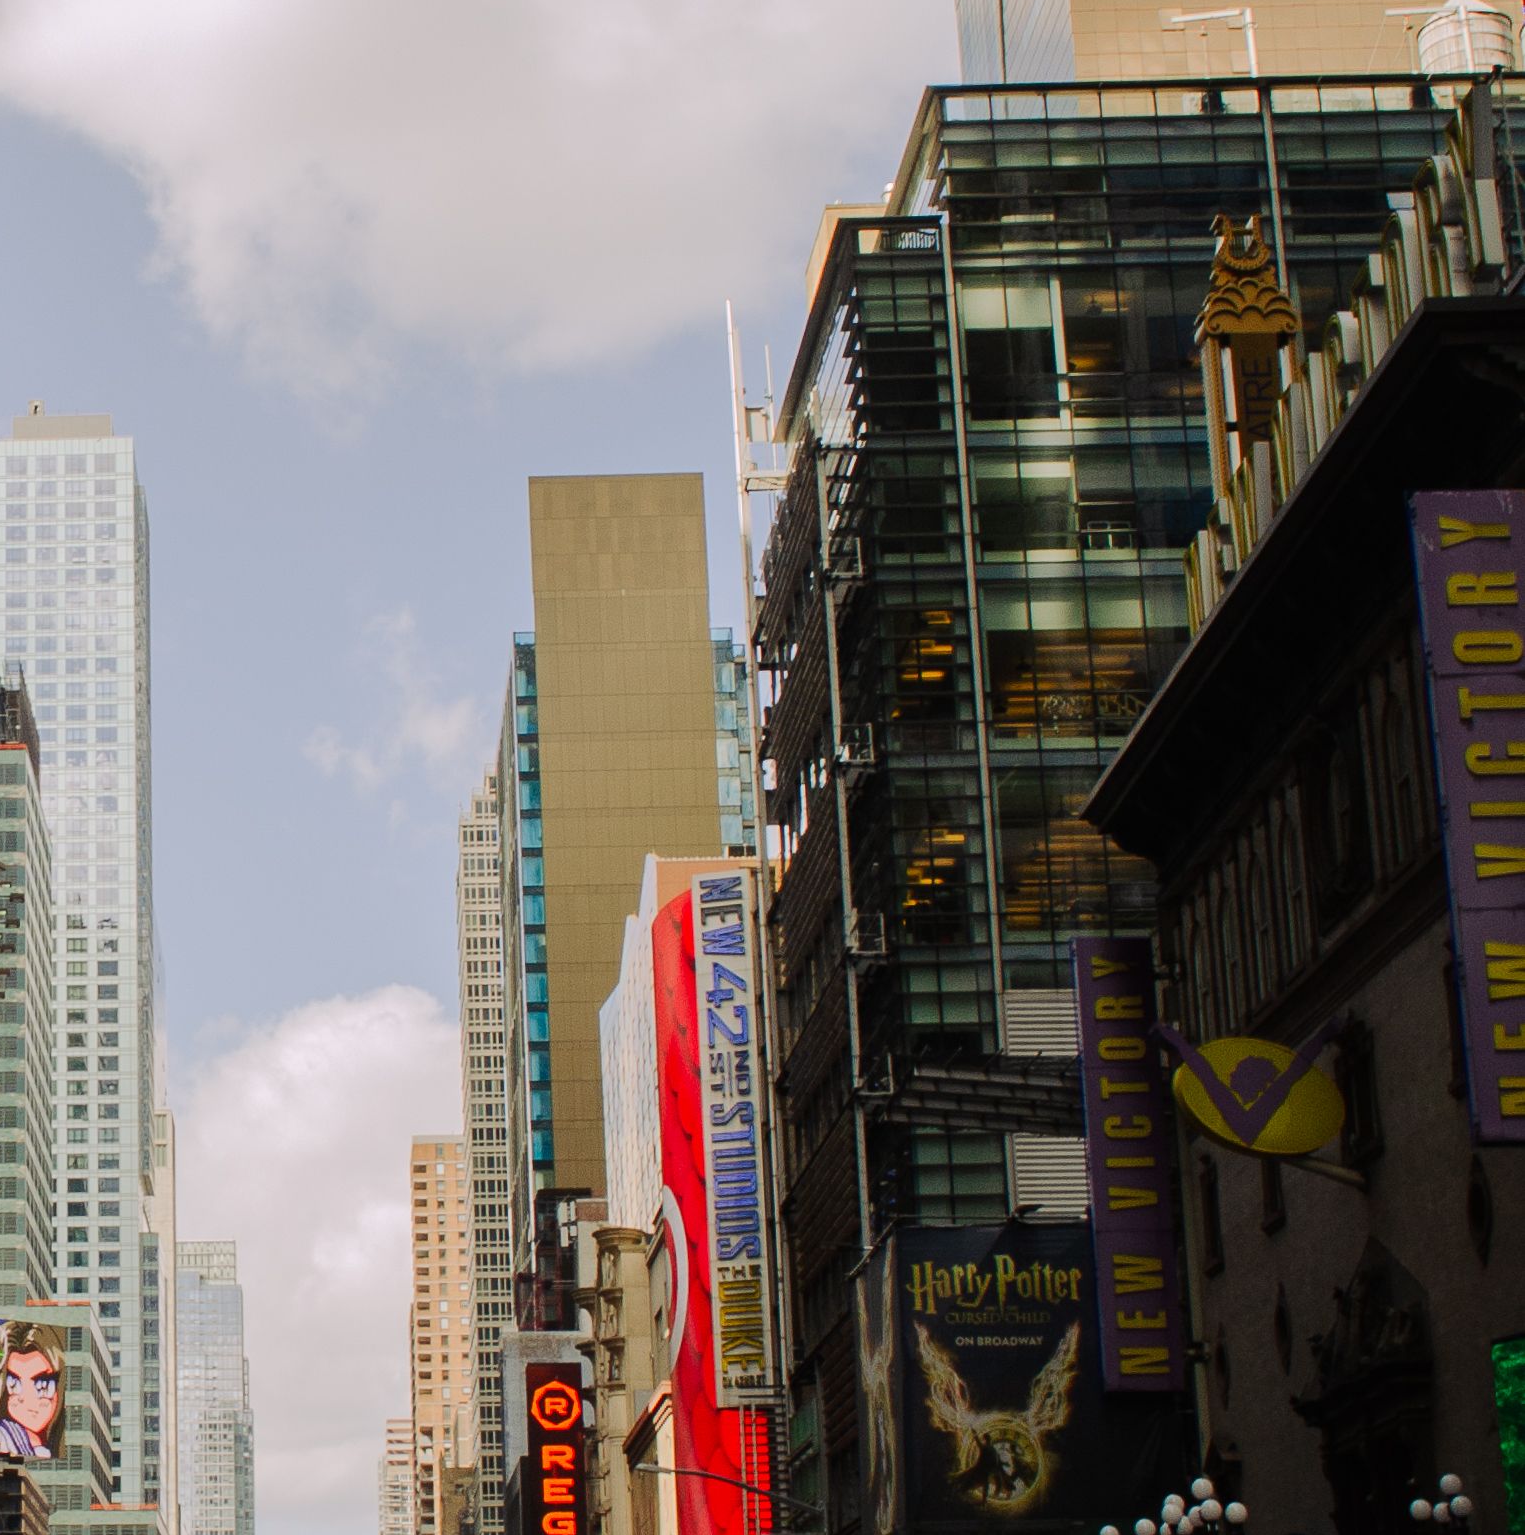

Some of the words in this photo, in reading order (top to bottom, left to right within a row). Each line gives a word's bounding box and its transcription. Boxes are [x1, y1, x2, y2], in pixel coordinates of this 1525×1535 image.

[699, 875, 746, 956] NEW
[707, 962, 750, 1049] 42
[1089, 954, 1160, 1211] VICTORY
[710, 1101, 761, 1261] STUDIOS
[716, 1279, 764, 1375] DUKE
[905, 1260, 993, 1315] Harry
[993, 1253, 1083, 1316] Potter
[1112, 1252, 1172, 1377] NEW
[954, 1335, 975, 1346] ON
[977, 1335, 1044, 1347] BROADWAY
